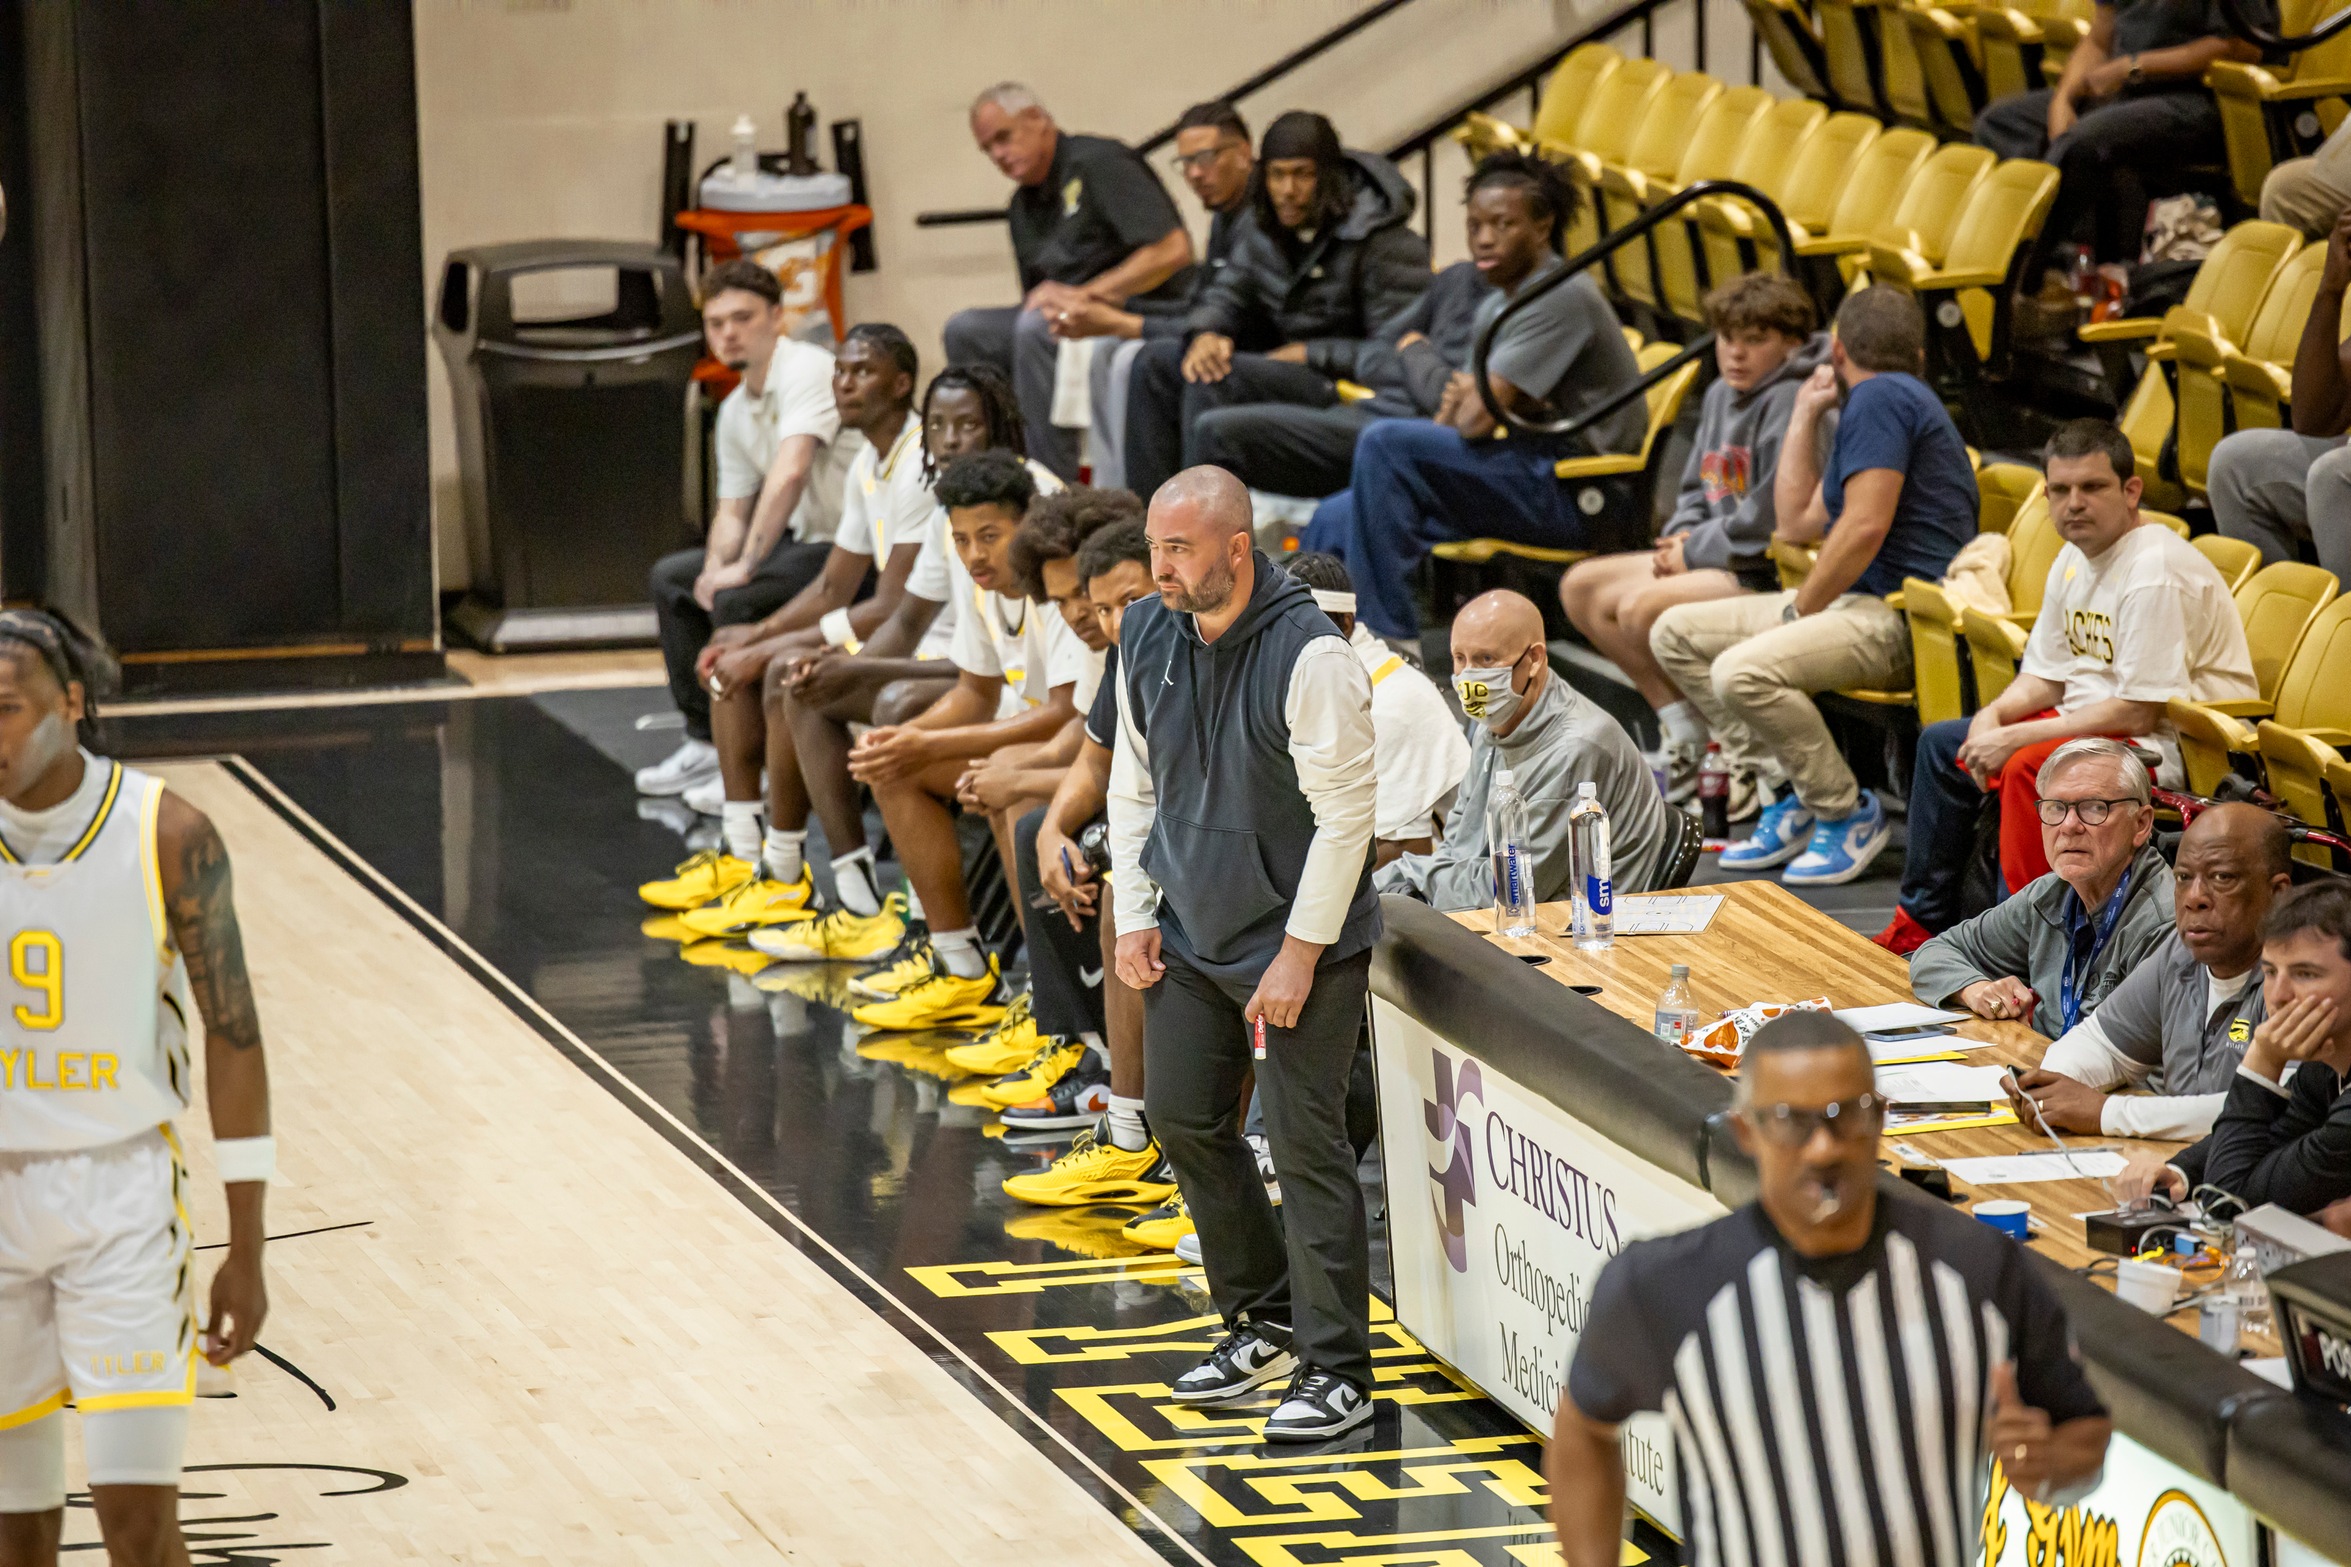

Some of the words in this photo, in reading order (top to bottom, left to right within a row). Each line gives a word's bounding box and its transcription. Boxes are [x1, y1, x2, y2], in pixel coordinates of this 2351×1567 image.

[1458, 681, 1488, 701] JC
[1508, 843, 1521, 905] smartwater
[10, 929, 64, 1031] 9
[0, 1047, 120, 1090] YLER
[1486, 1110, 1620, 1259] CHRISTUS
[1499, 1321, 1575, 1418] Medici
